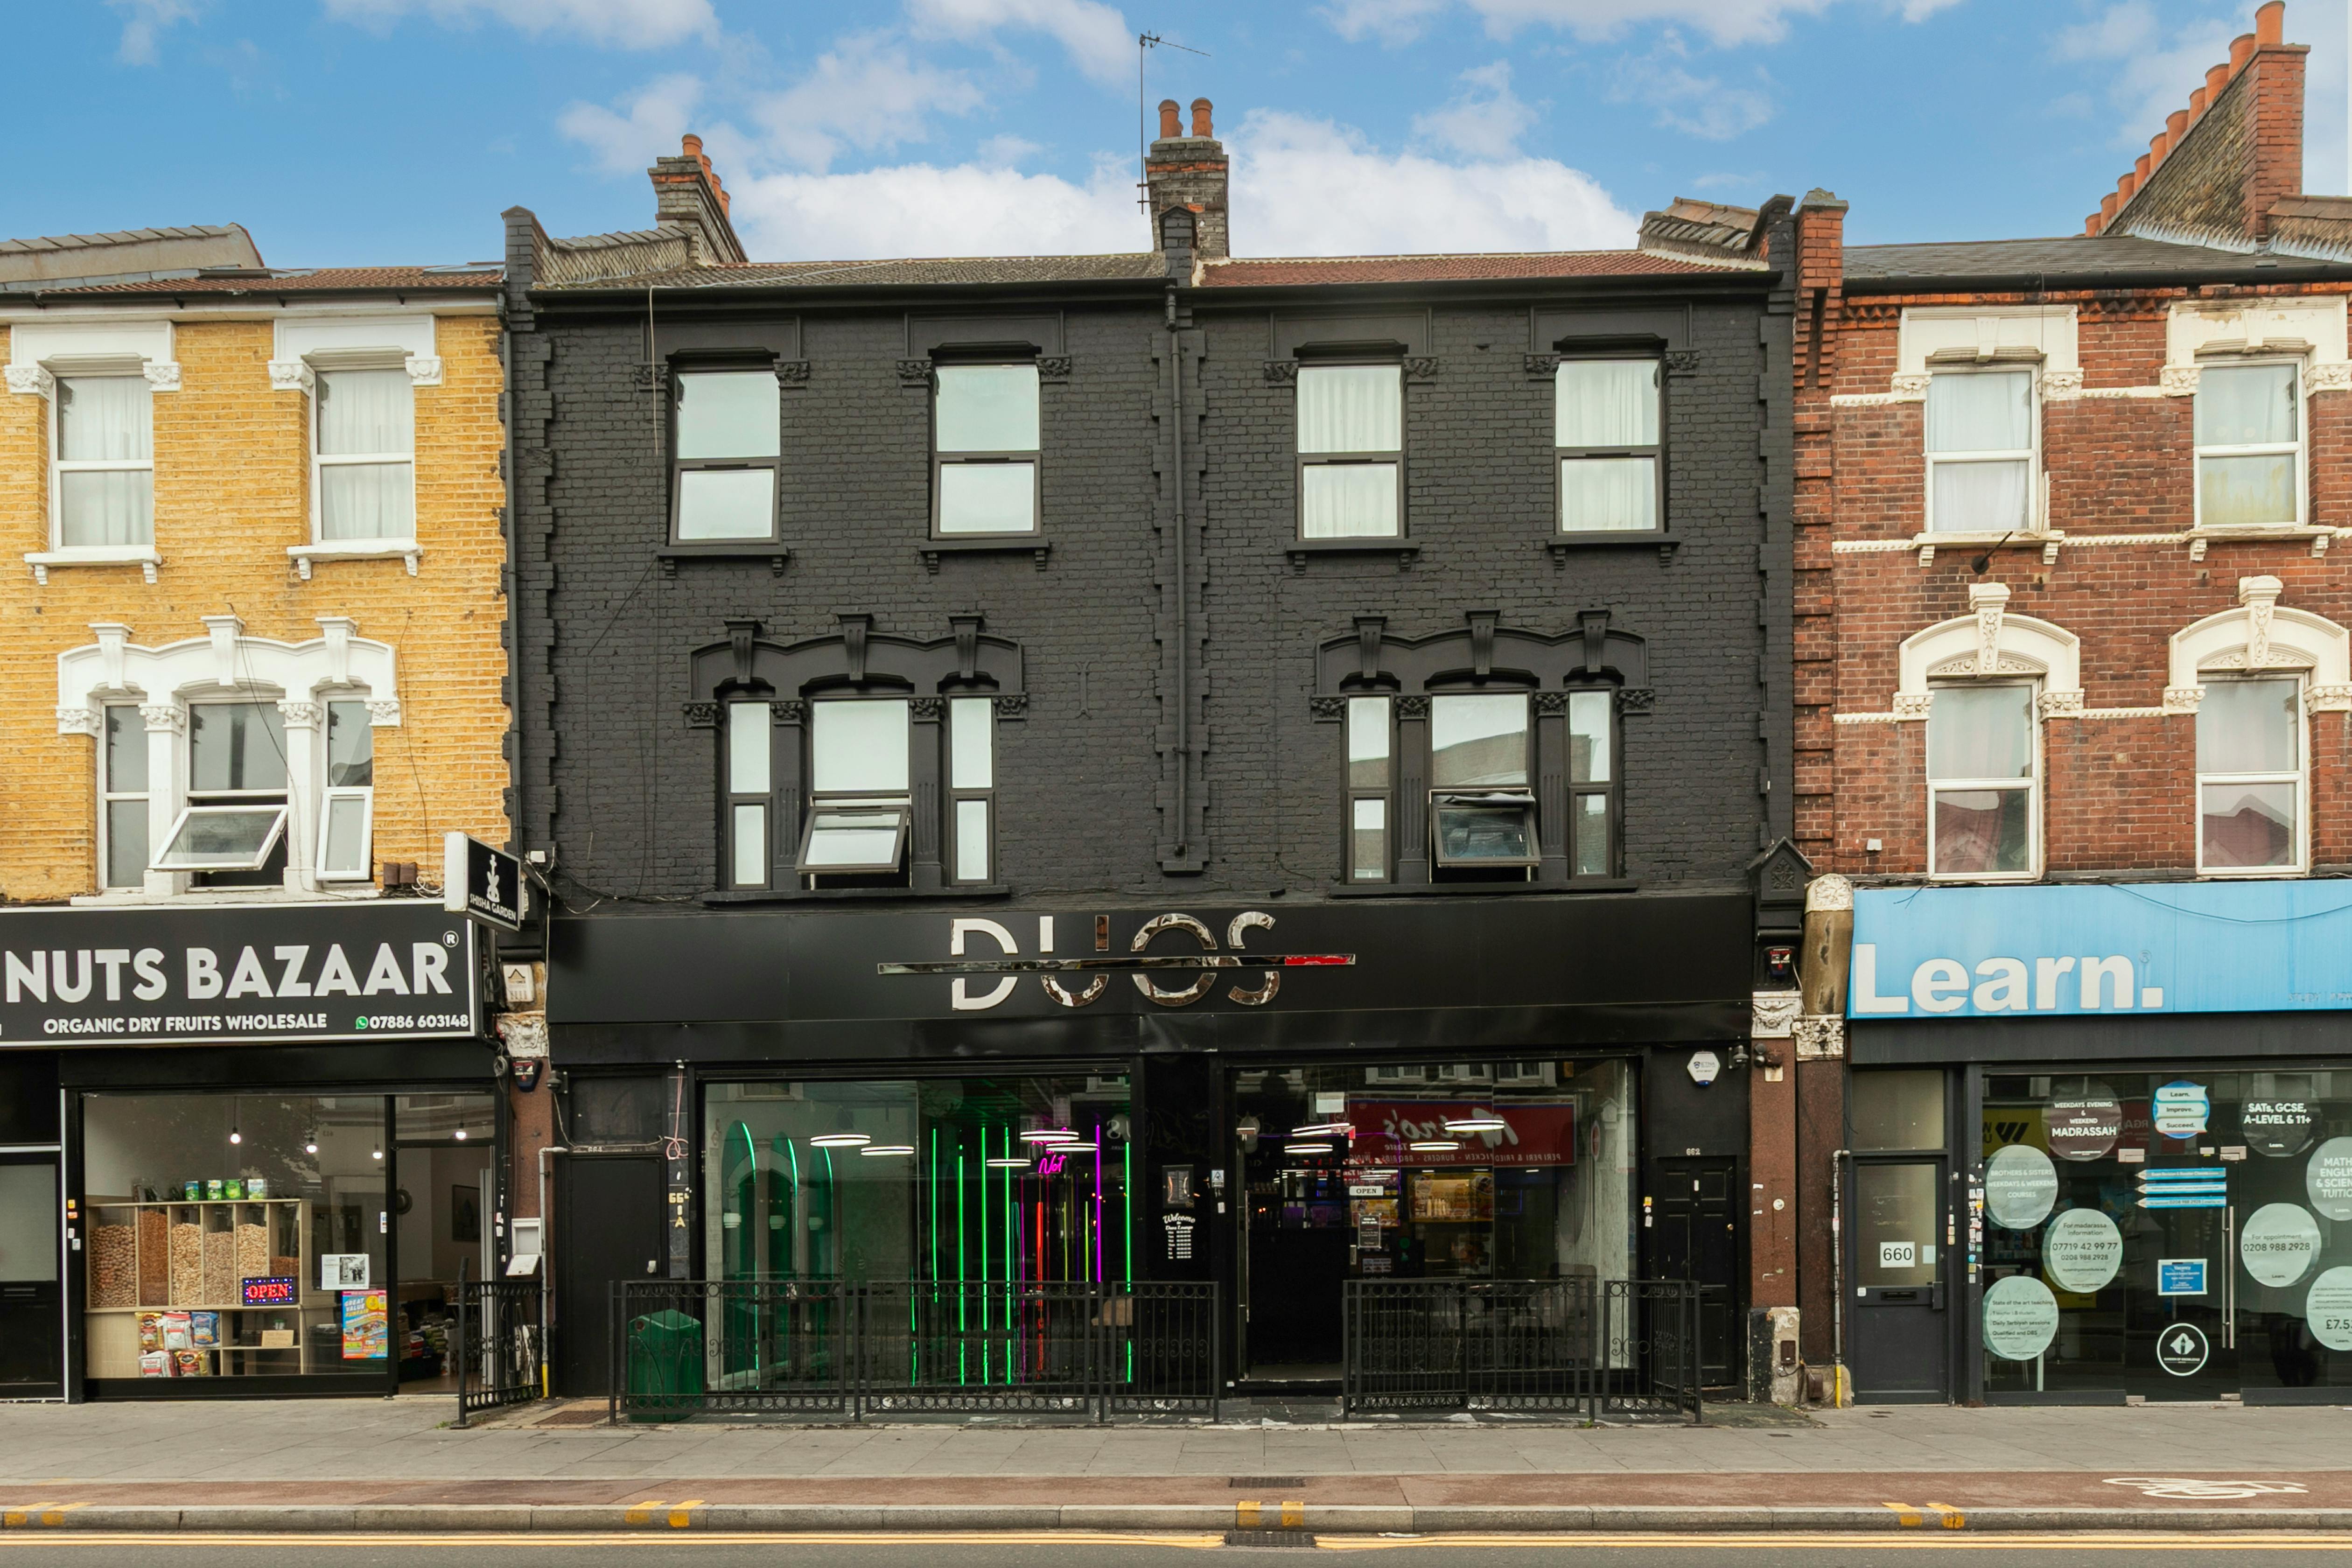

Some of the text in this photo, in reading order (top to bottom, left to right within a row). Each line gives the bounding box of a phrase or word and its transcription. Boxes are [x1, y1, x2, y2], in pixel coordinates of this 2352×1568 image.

[469, 893, 517, 921] SHISHA GARDEN
[951, 911, 1280, 1010] DUOS
[5, 948, 168, 1003] NUTS
[186, 942, 453, 1000] BAZAAR
[1855, 943, 2163, 1013] Learn.
[43, 1014, 327, 1034] ORGANIC DRY FRUITS WHOLESALE
[369, 1015, 469, 1029] 07886 603148
[2248, 1103, 2307, 1113] SATs, GCSE,
[2243, 1114, 2312, 1124] A-LEVEL & 11+
[2052, 1127, 2117, 1137] MADRASSAH
[1038, 1154, 1067, 1175] Not
[2316, 1179, 2323, 1188] &
[675, 1216, 686, 1227] A
[1162, 1213, 1196, 1224] Welcome
[1883, 1248, 1912, 1260] 660
[248, 1284, 289, 1299] OPEN
[2326, 1319, 2352, 1330] £7.5
